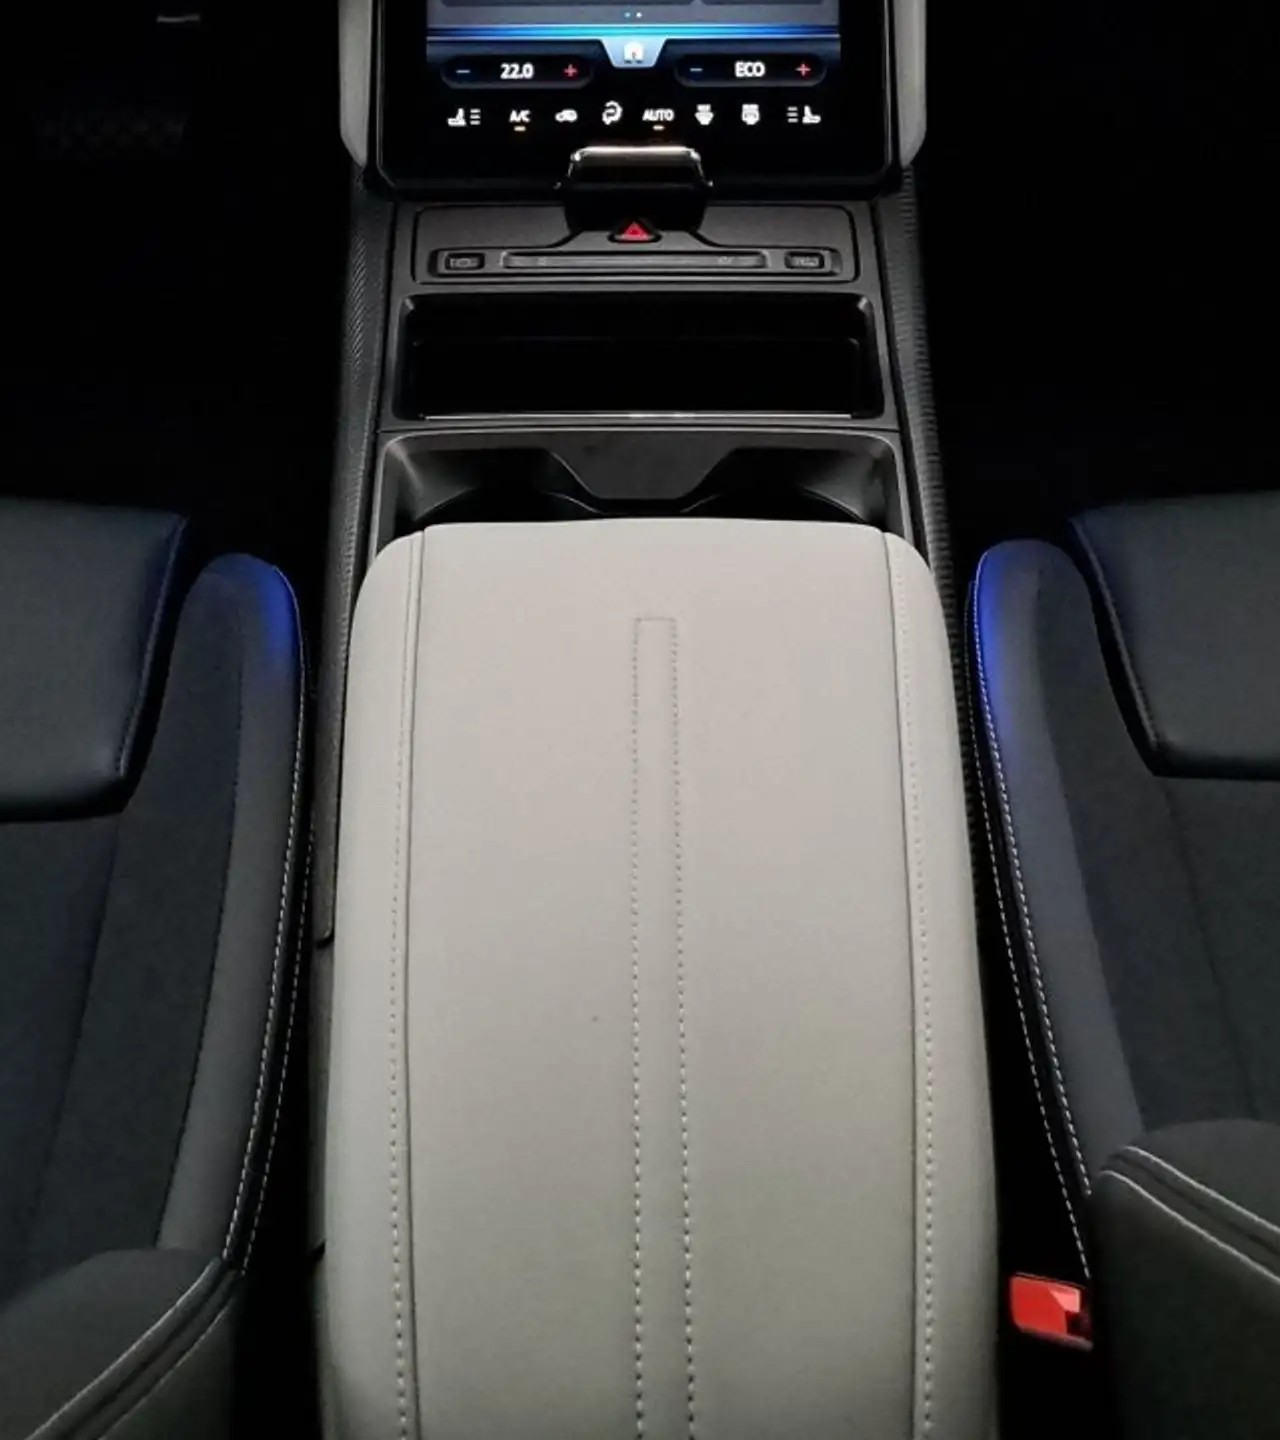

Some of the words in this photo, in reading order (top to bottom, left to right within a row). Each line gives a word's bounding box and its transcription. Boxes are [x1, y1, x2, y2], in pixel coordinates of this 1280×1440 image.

[500, 63, 535, 80] 22.0
[735, 61, 766, 78] ECO
[509, 110, 531, 123] A/C
[642, 109, 675, 122] AUTO
